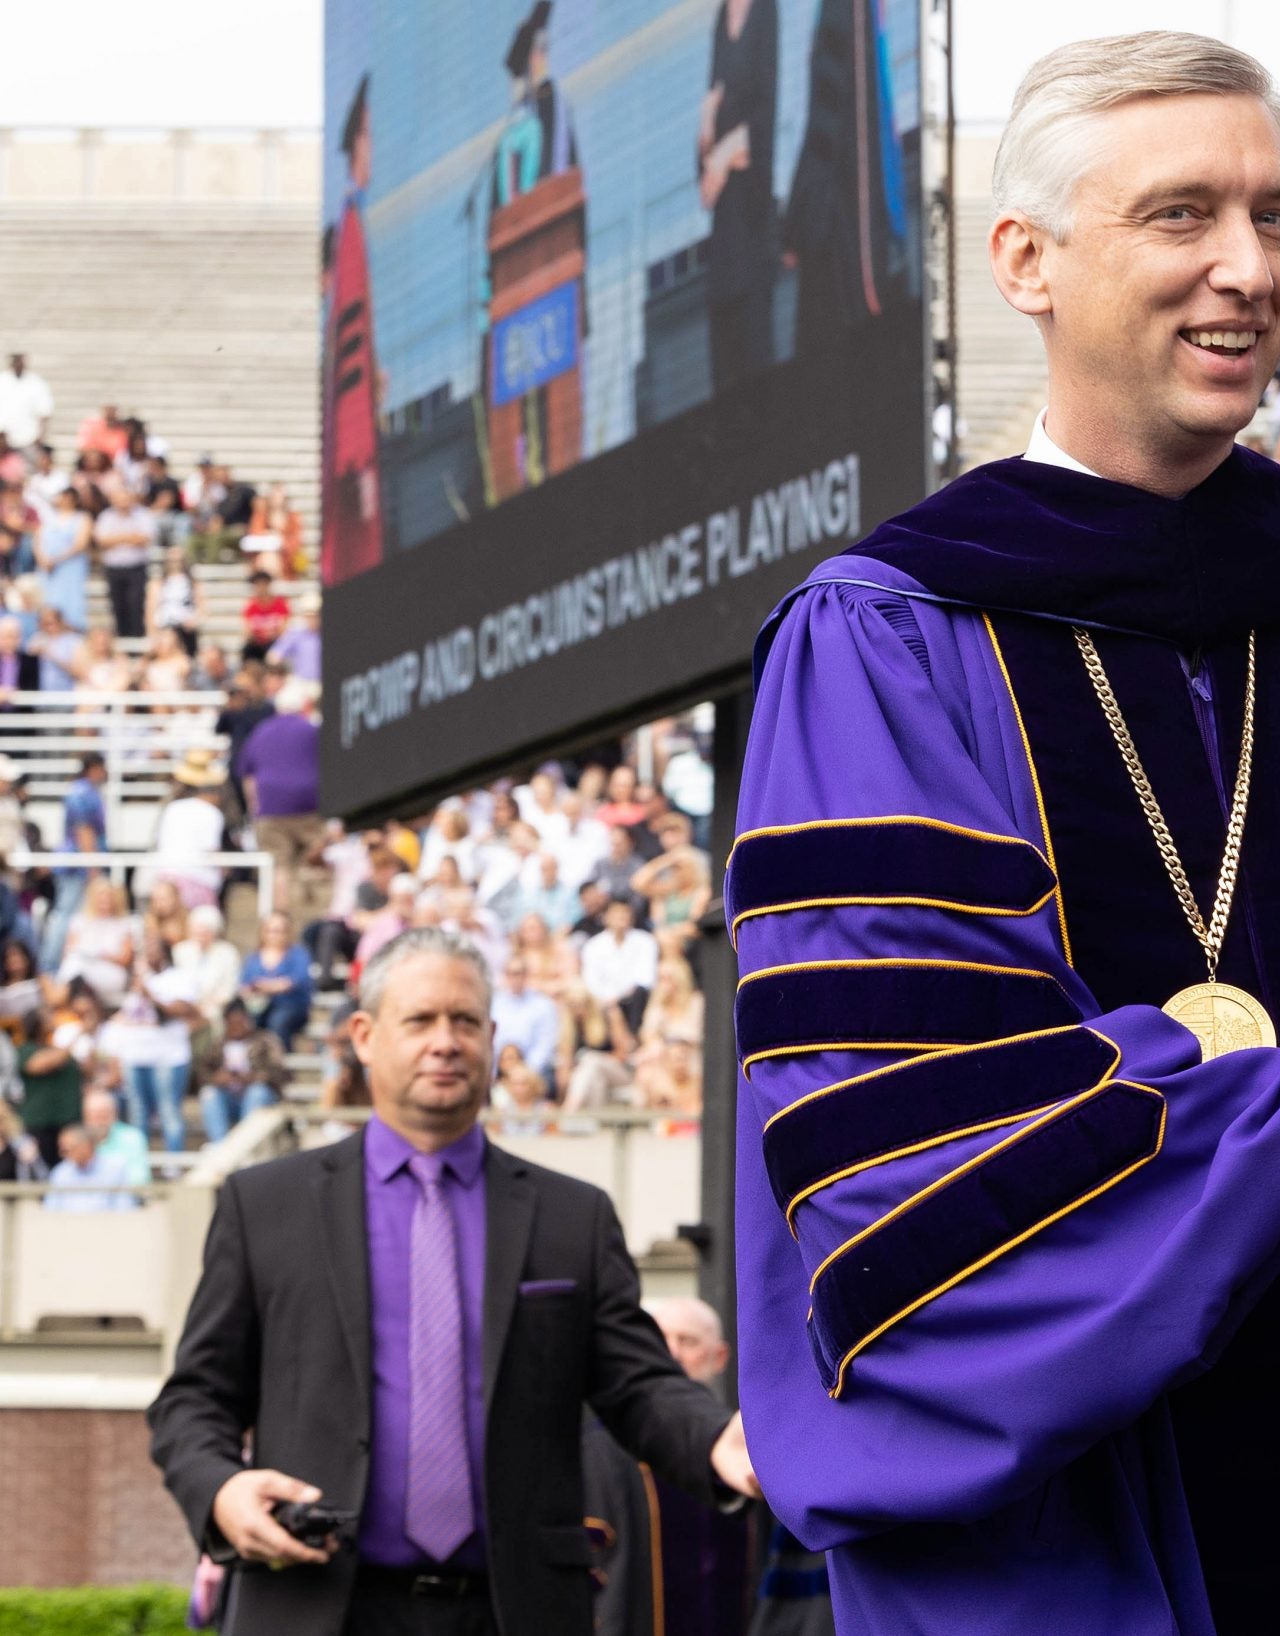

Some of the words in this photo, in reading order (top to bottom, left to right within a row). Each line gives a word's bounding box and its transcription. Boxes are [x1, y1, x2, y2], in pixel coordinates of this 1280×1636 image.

[341, 651, 417, 748] [POMP
[419, 628, 477, 706] AND
[479, 524, 704, 680] CIRCUMSTANCE
[708, 454, 860, 586] PLAYING]
[1173, 986, 1218, 1007] CAROLINA
